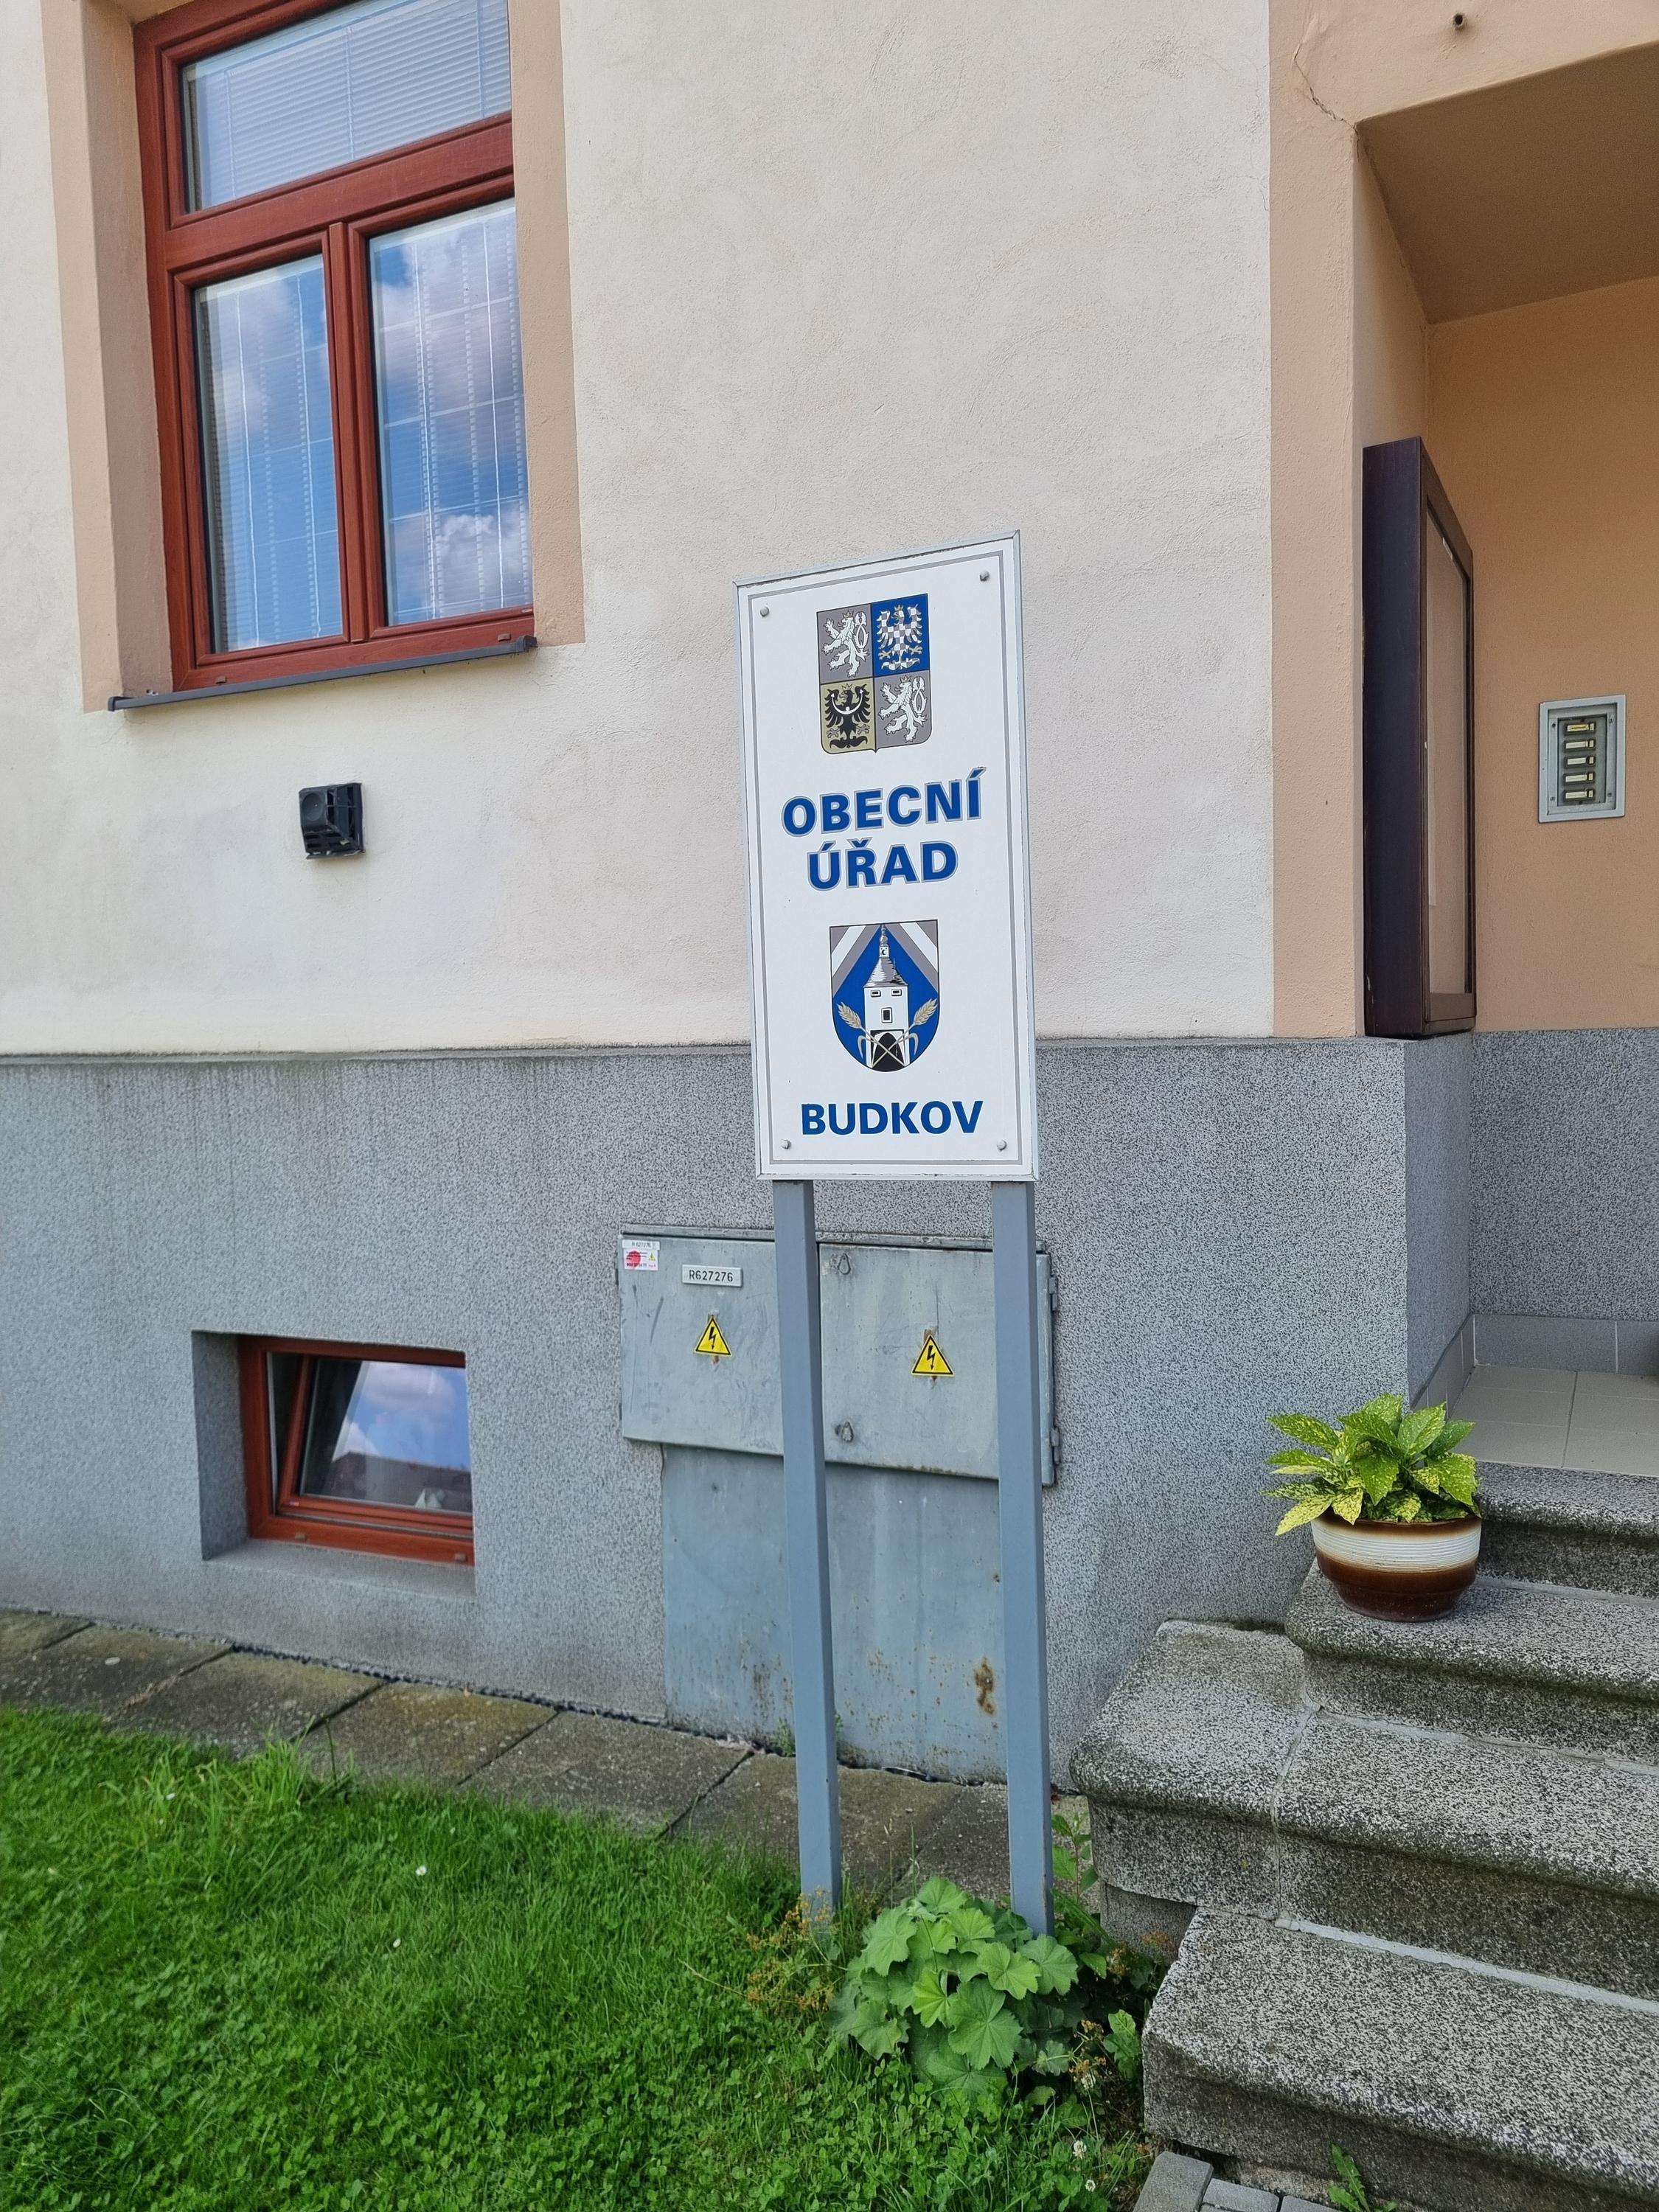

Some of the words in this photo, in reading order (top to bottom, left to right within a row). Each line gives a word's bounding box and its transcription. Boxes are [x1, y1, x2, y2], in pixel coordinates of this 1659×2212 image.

[781, 767, 987, 837] OBECNÍ
[807, 837, 959, 891] ÚŘAD
[801, 1100, 984, 1135] BUDKOV
[688, 1269, 734, 1282] R627276
